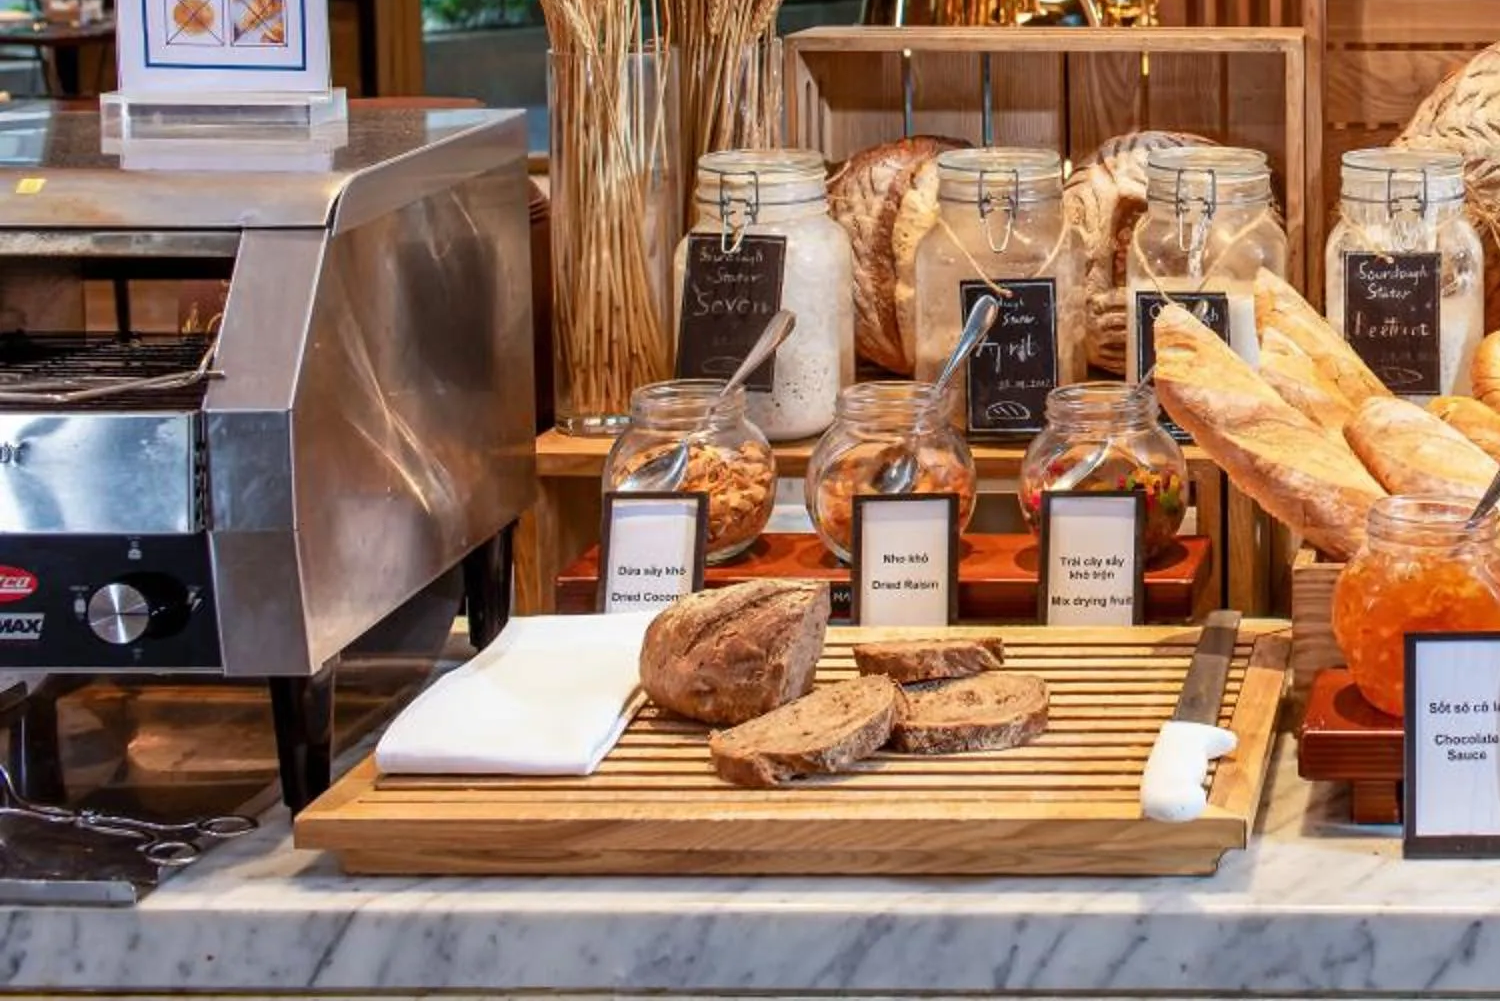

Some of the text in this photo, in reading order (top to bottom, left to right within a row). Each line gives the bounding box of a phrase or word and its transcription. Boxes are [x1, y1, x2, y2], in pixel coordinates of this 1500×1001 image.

[883, 554, 906, 564] Nho
[872, 580, 901, 590] Dried
[611, 591, 688, 602] Dried Cocon
[1051, 595, 1071, 606] Mix
[1073, 595, 1107, 608] drying
[1435, 733, 1499, 746] Chocolate
[1447, 749, 1487, 761] Sauce
